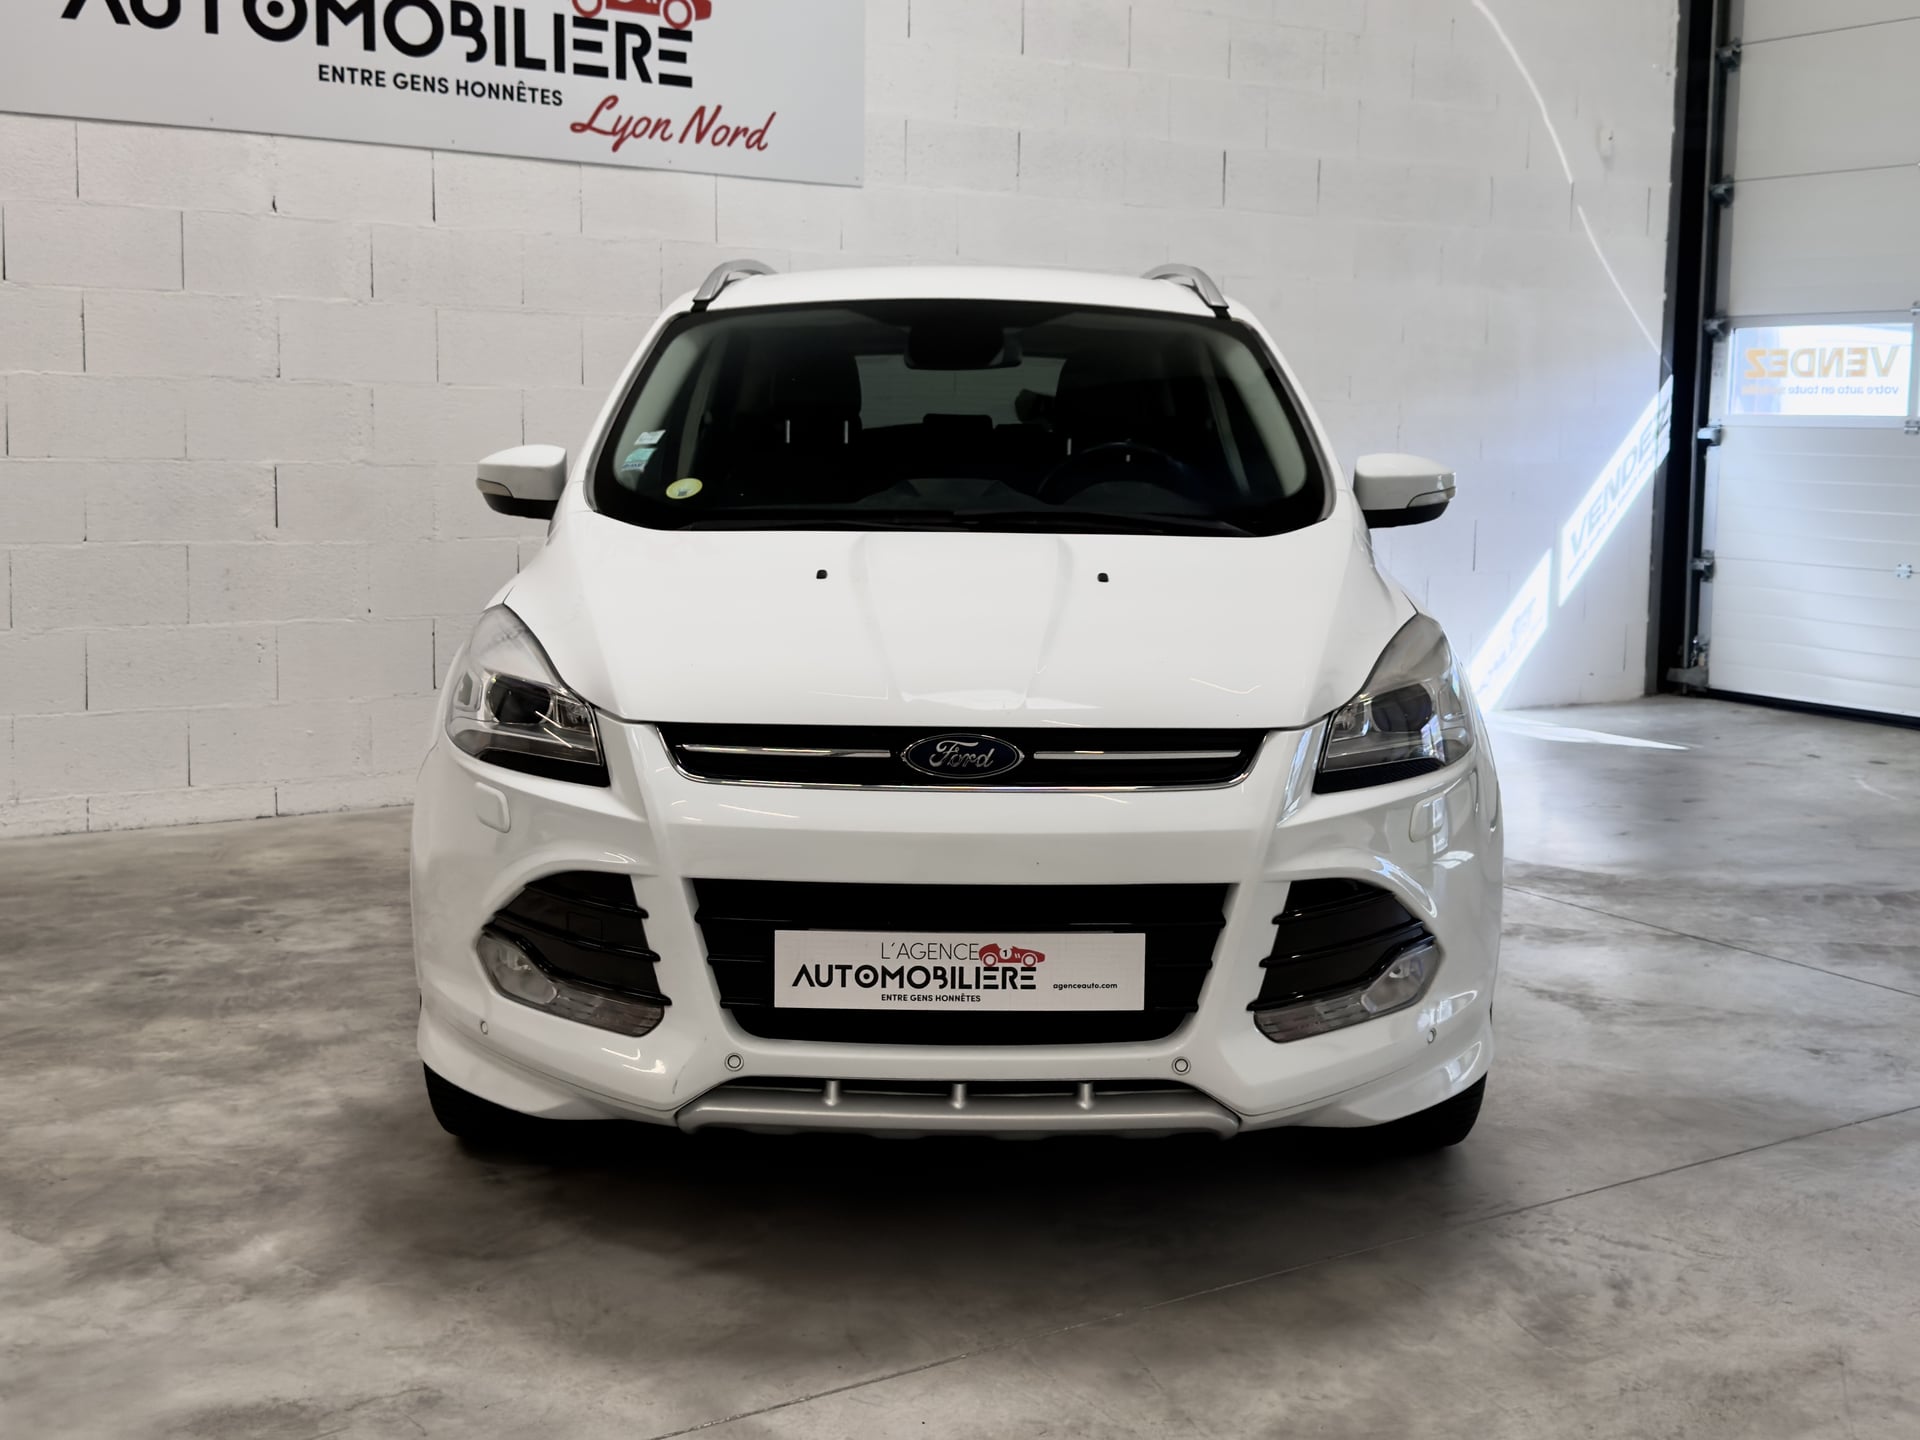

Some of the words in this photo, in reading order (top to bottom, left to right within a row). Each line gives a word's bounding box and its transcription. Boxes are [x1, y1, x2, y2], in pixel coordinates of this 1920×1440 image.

[317, 63, 387, 88] ENTRE
[392, 72, 450, 95] GENS
[455, 80, 563, 107] HONNÊTES
[570, 94, 674, 153] Lyon
[678, 104, 777, 152] Nord
[928, 740, 996, 768] Ford
[881, 993, 908, 1002] ENTRE
[909, 994, 934, 1002] GENS
[935, 993, 981, 1003] HONNÊTES
[1052, 982, 1118, 991] agenceauto.com
